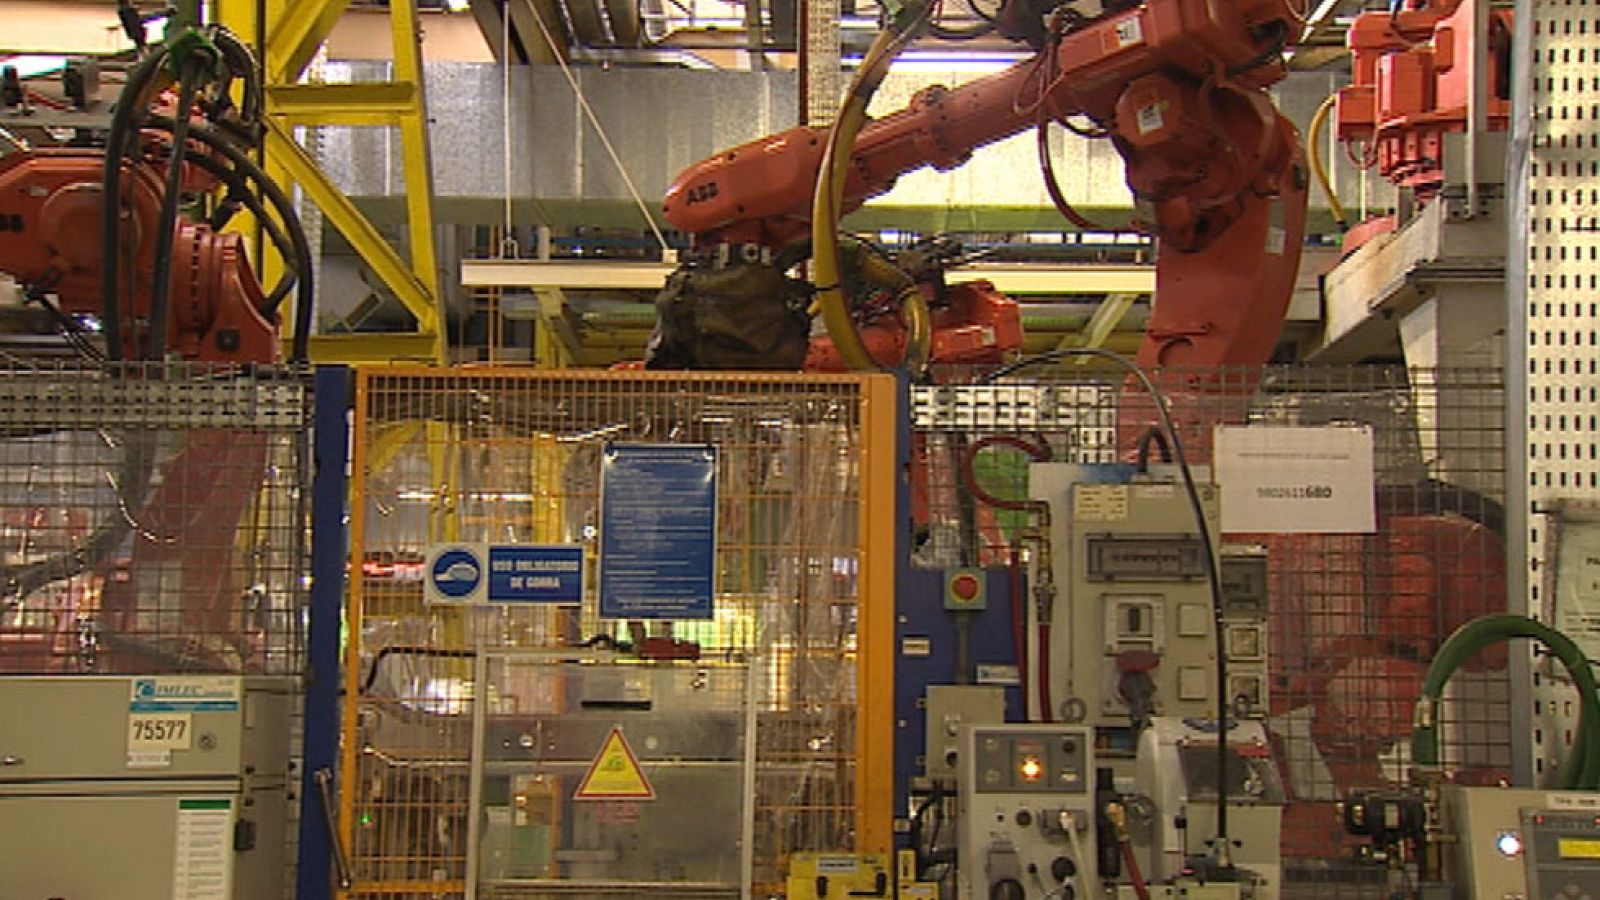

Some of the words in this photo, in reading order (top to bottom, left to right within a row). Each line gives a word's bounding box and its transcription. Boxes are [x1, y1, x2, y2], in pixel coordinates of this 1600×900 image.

[687, 182, 719, 206] ABB
[493, 561, 512, 571] USO
[516, 561, 578, 571] OBLIGATORIO
[511, 576, 523, 588] DE
[133, 720, 186, 740] 75577
